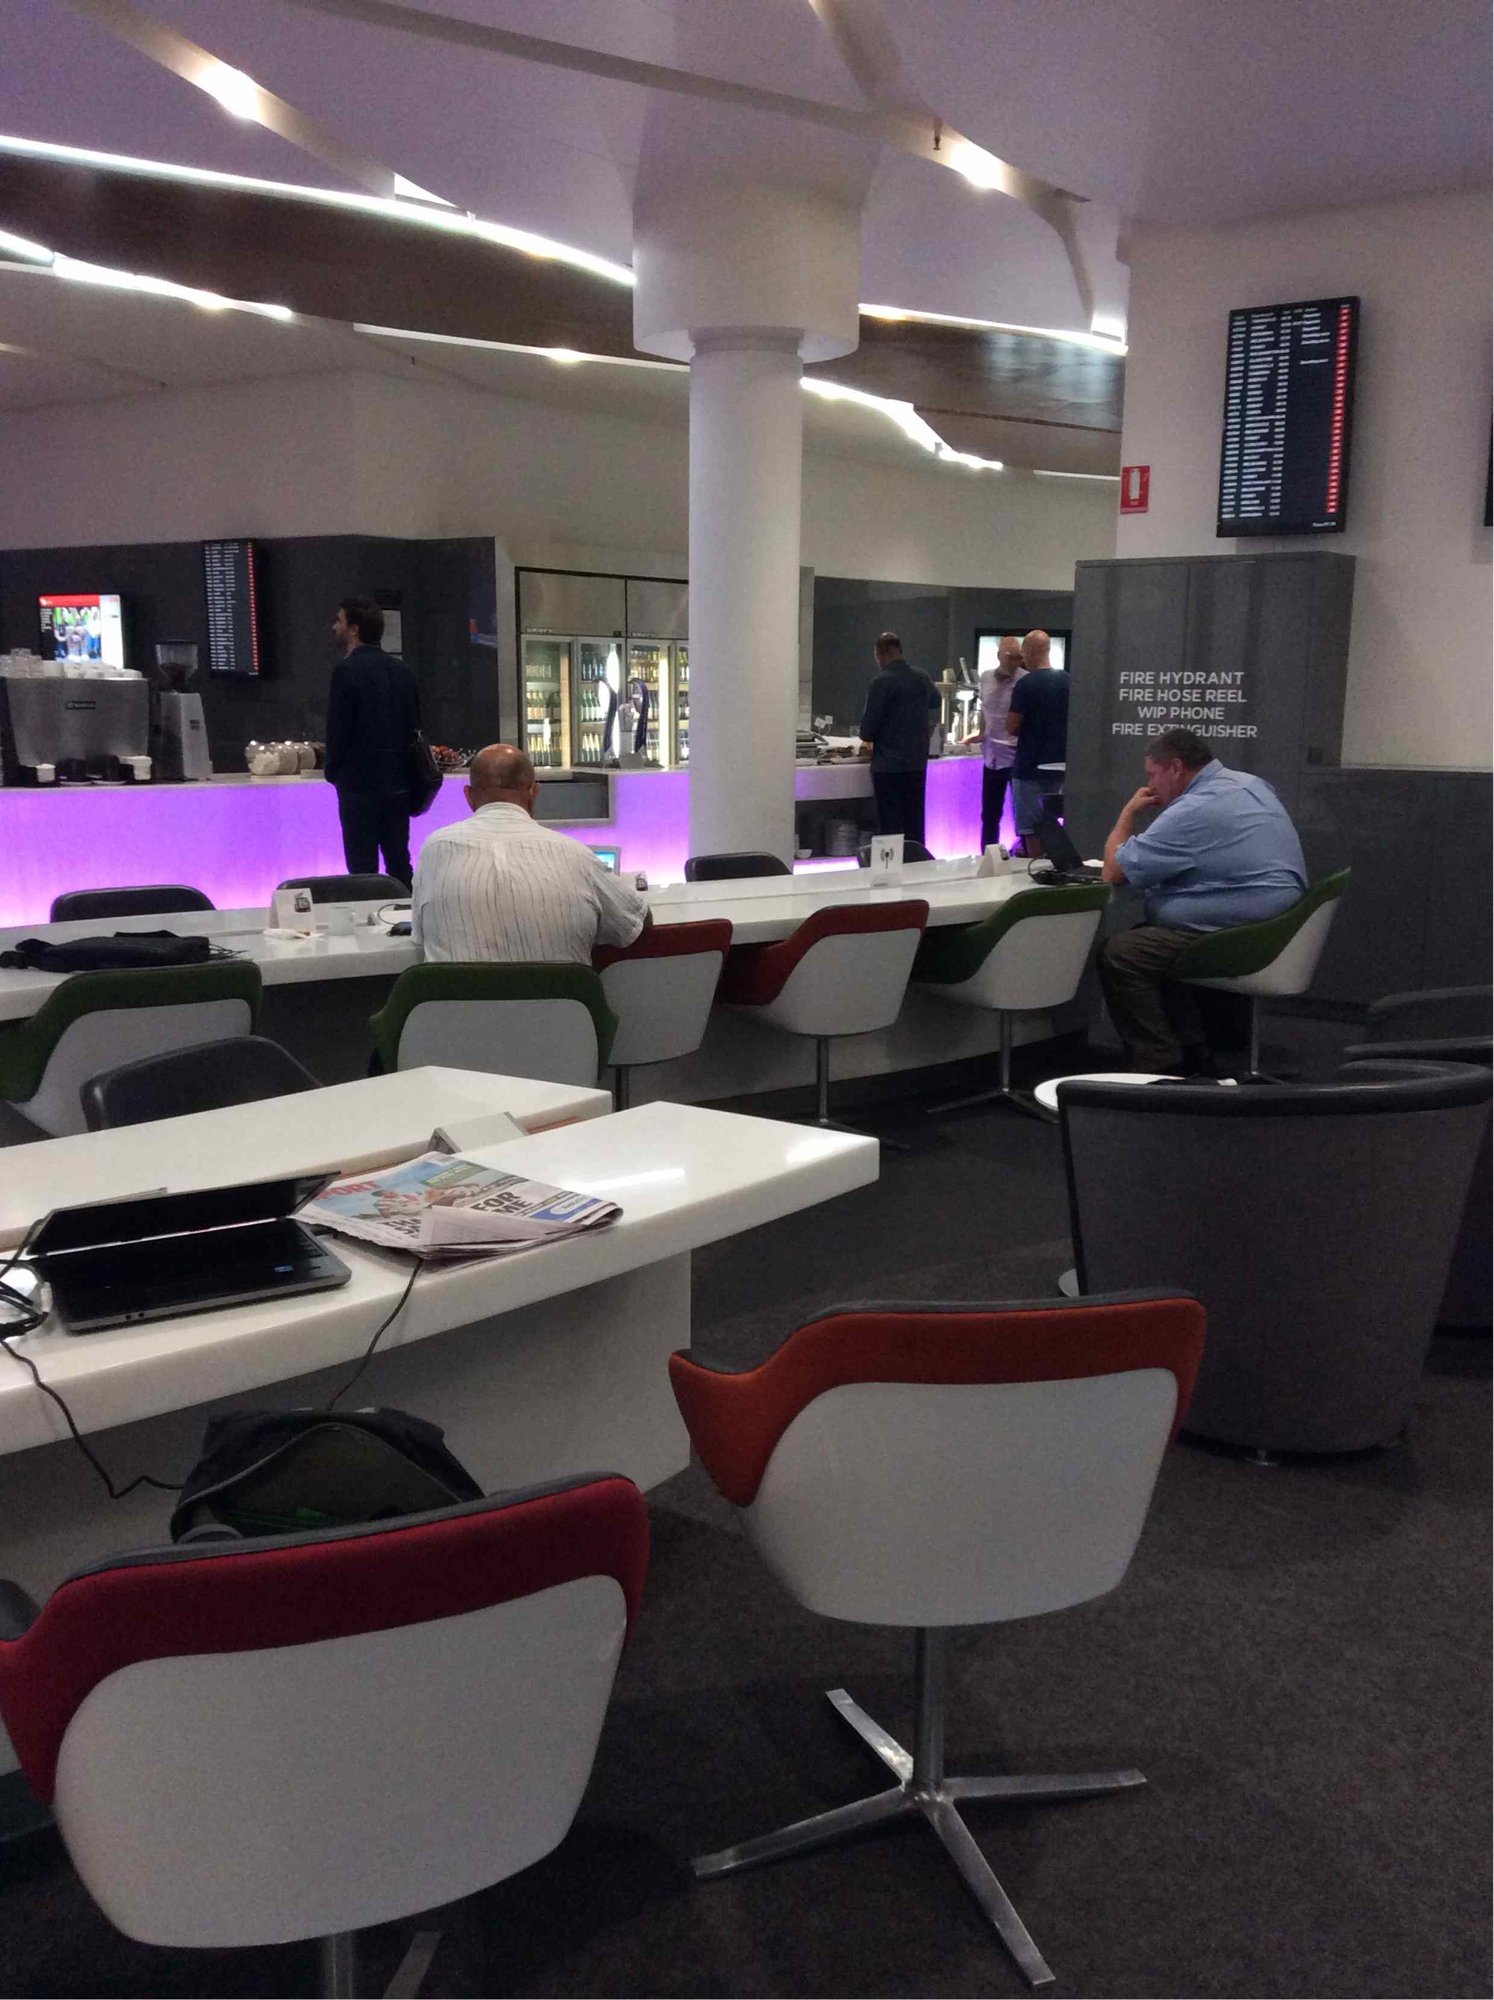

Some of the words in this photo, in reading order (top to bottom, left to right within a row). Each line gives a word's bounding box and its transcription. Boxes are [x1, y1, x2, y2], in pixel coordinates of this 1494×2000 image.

[1119, 671, 1155, 685] FIRE
[1159, 671, 1245, 685] HYDRANT
[1119, 688, 1154, 702] FIRE
[1157, 688, 1202, 703] HOSE
[1205, 689, 1247, 703] REEL
[1137, 706, 1167, 719] WIP
[1170, 706, 1225, 720] PHONE
[1111, 722, 1143, 736] FIRE
[1147, 723, 1257, 738] EXGUISHER
[314, 1181, 380, 1201] PORT
[469, 1191, 522, 1212] FOR
